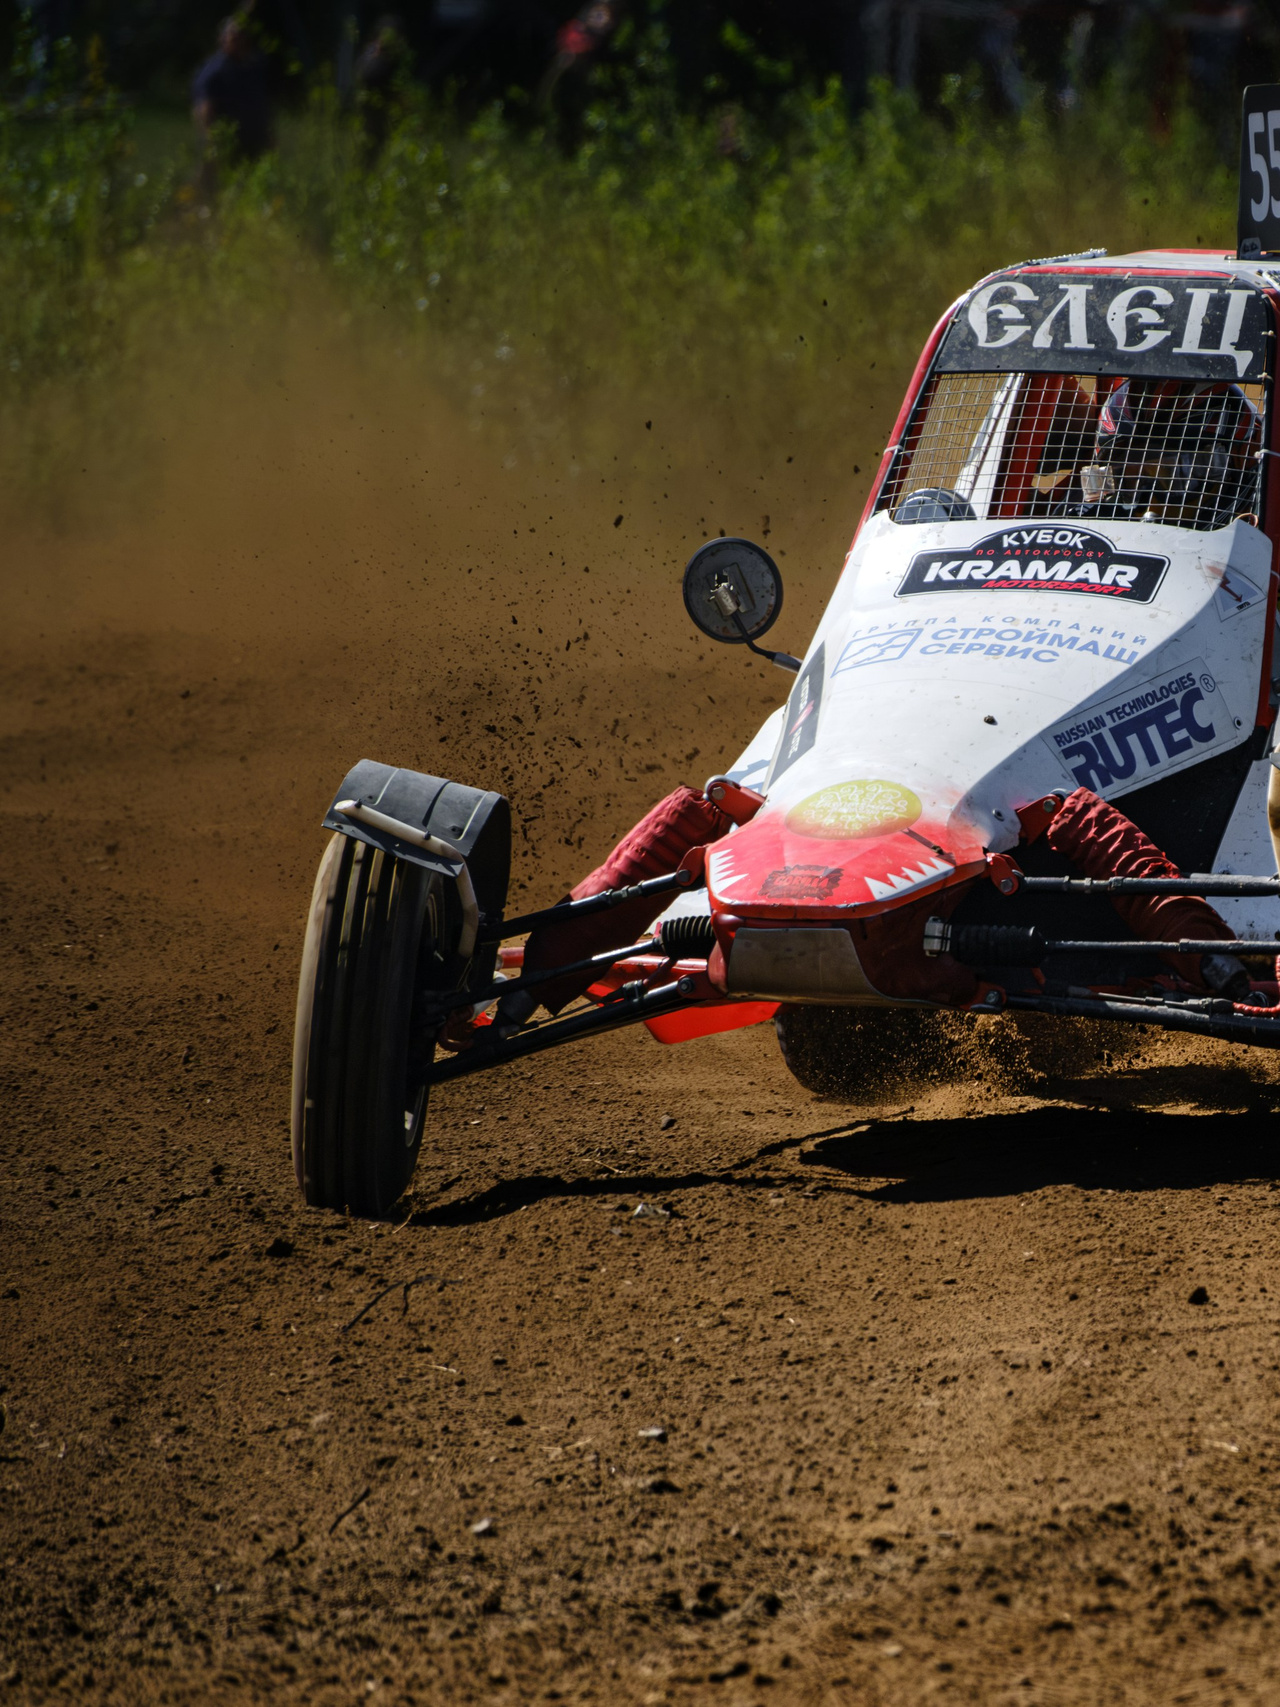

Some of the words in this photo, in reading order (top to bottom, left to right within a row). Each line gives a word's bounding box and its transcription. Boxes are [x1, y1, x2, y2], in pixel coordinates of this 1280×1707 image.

[1002, 529, 1091, 549] КУБОК
[1003, 549, 1105, 558] АВТОКРОССУ
[923, 559, 1139, 588] KRAMAR
[981, 579, 1131, 595] MOTORSPORT
[852, 616, 957, 638] ГРУППА
[981, 615, 1147, 646] КОМПАНИЙ
[919, 642, 1060, 663] СЕРВИС
[931, 627, 1139, 665] СТРОЙМАШ
[1053, 714, 1107, 748] RUSSIAN
[1106, 672, 1197, 723] TECHNOLOGIES
[1061, 687, 1216, 793] RUTEC
